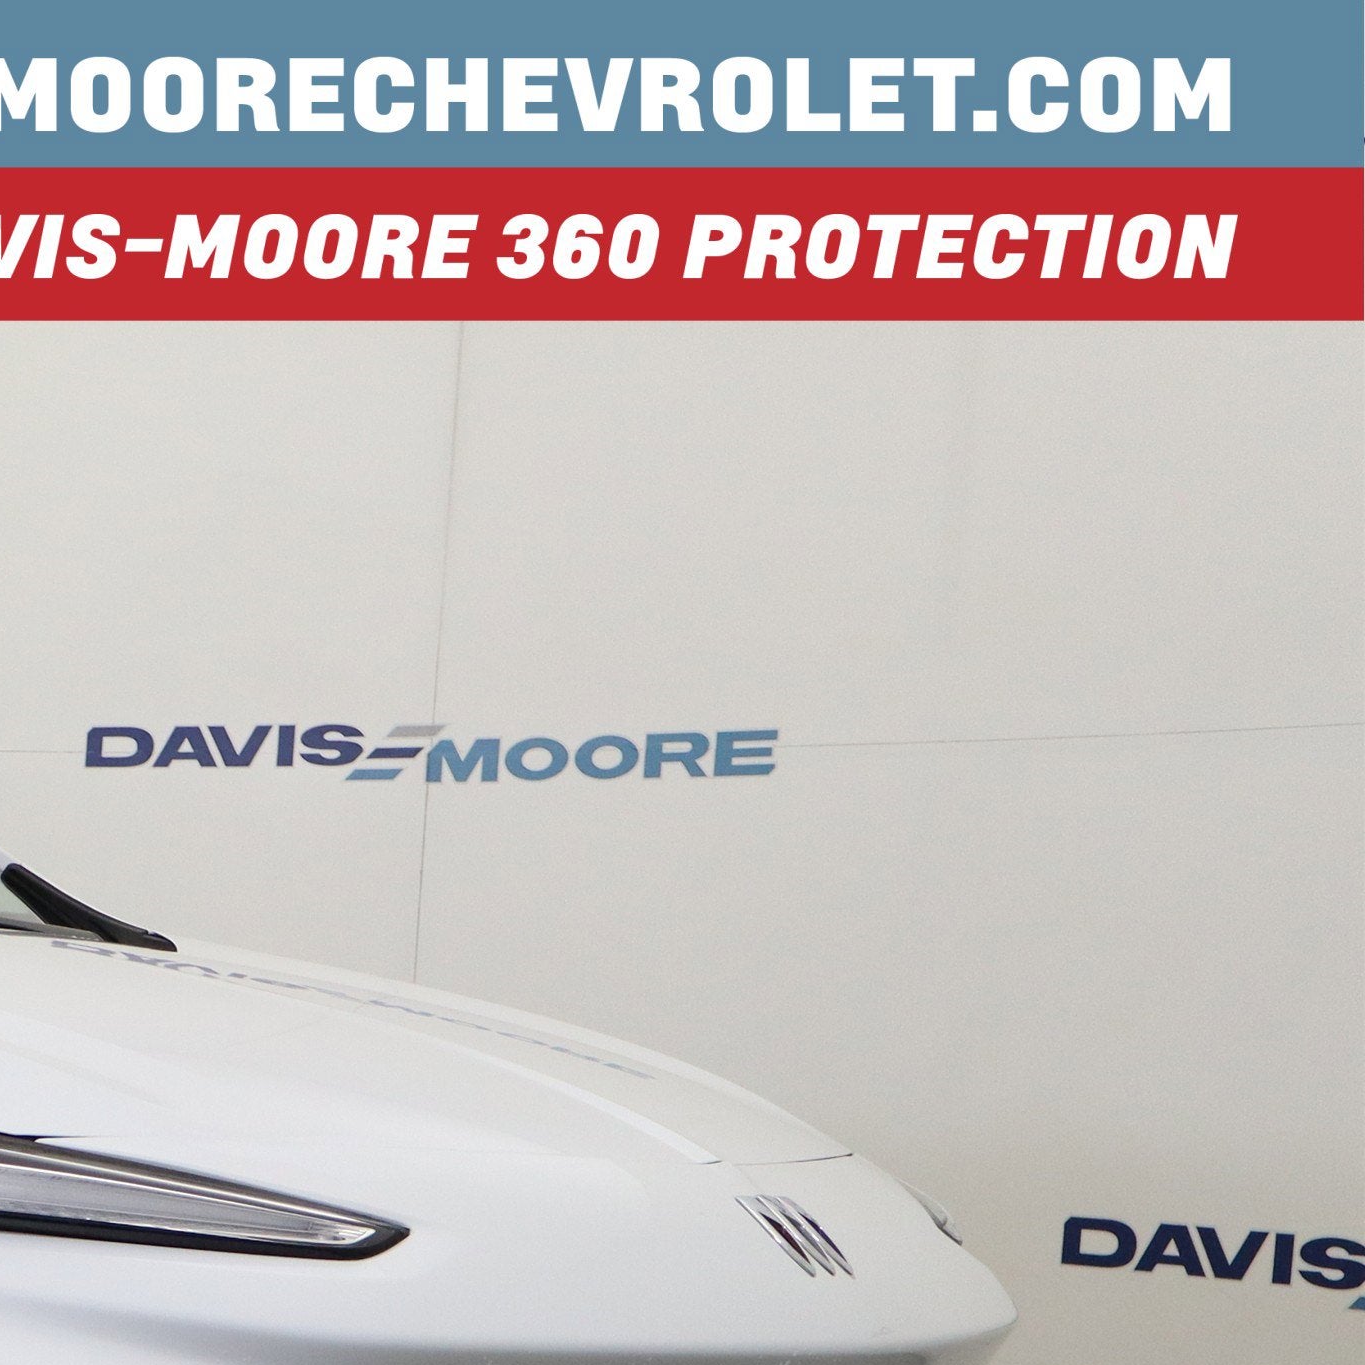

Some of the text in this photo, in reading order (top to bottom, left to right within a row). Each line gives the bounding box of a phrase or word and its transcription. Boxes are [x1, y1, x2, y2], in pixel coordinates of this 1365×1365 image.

[85, 724, 779, 783] DAVIS MOORE
[1061, 1216, 1365, 1290] DAVIS
